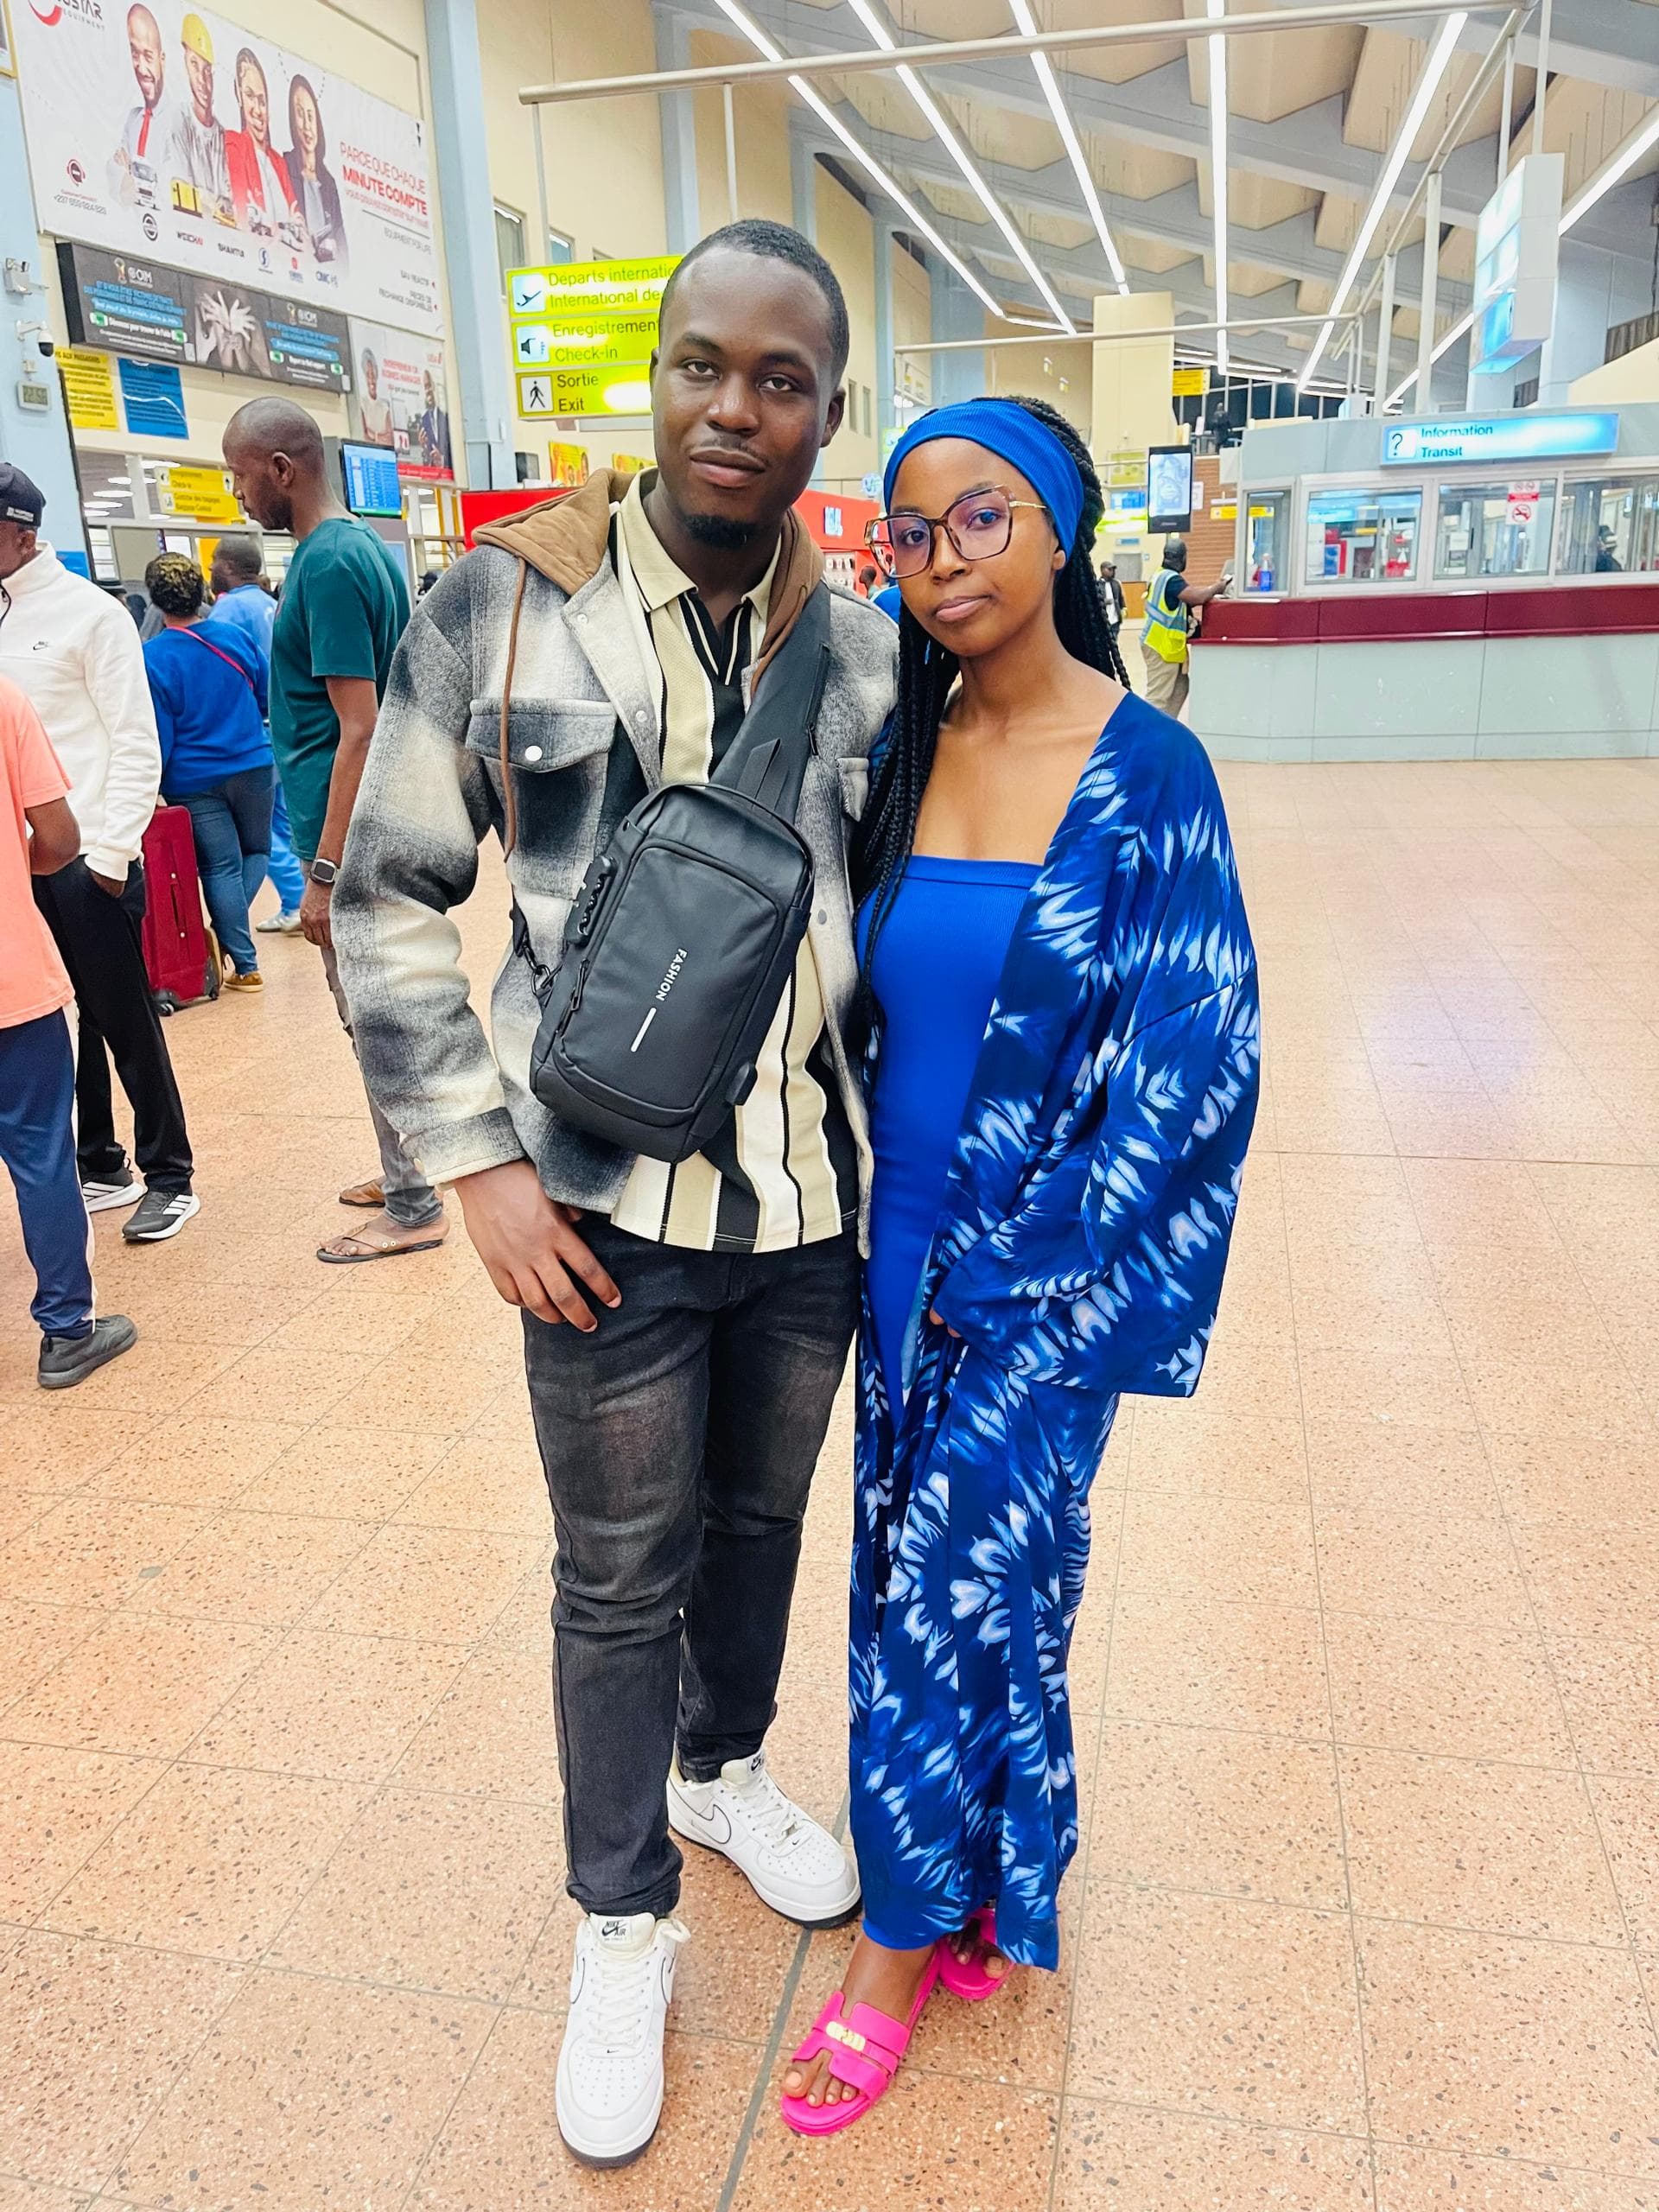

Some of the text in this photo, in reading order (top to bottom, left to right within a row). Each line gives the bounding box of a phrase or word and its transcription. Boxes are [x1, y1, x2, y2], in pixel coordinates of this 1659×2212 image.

[342, 164, 385, 197] MINUTE
[385, 184, 428, 216] COMPTE
[550, 288, 662, 308] International de
[553, 319, 658, 338] Enregistremen
[555, 346, 618, 362] Check-in
[556, 373, 599, 388] Sortie
[558, 397, 585, 412] Exit
[1421, 425, 1493, 439] Information
[1421, 446, 1462, 458] Transit
[655, 948, 688, 1001] FASHION
